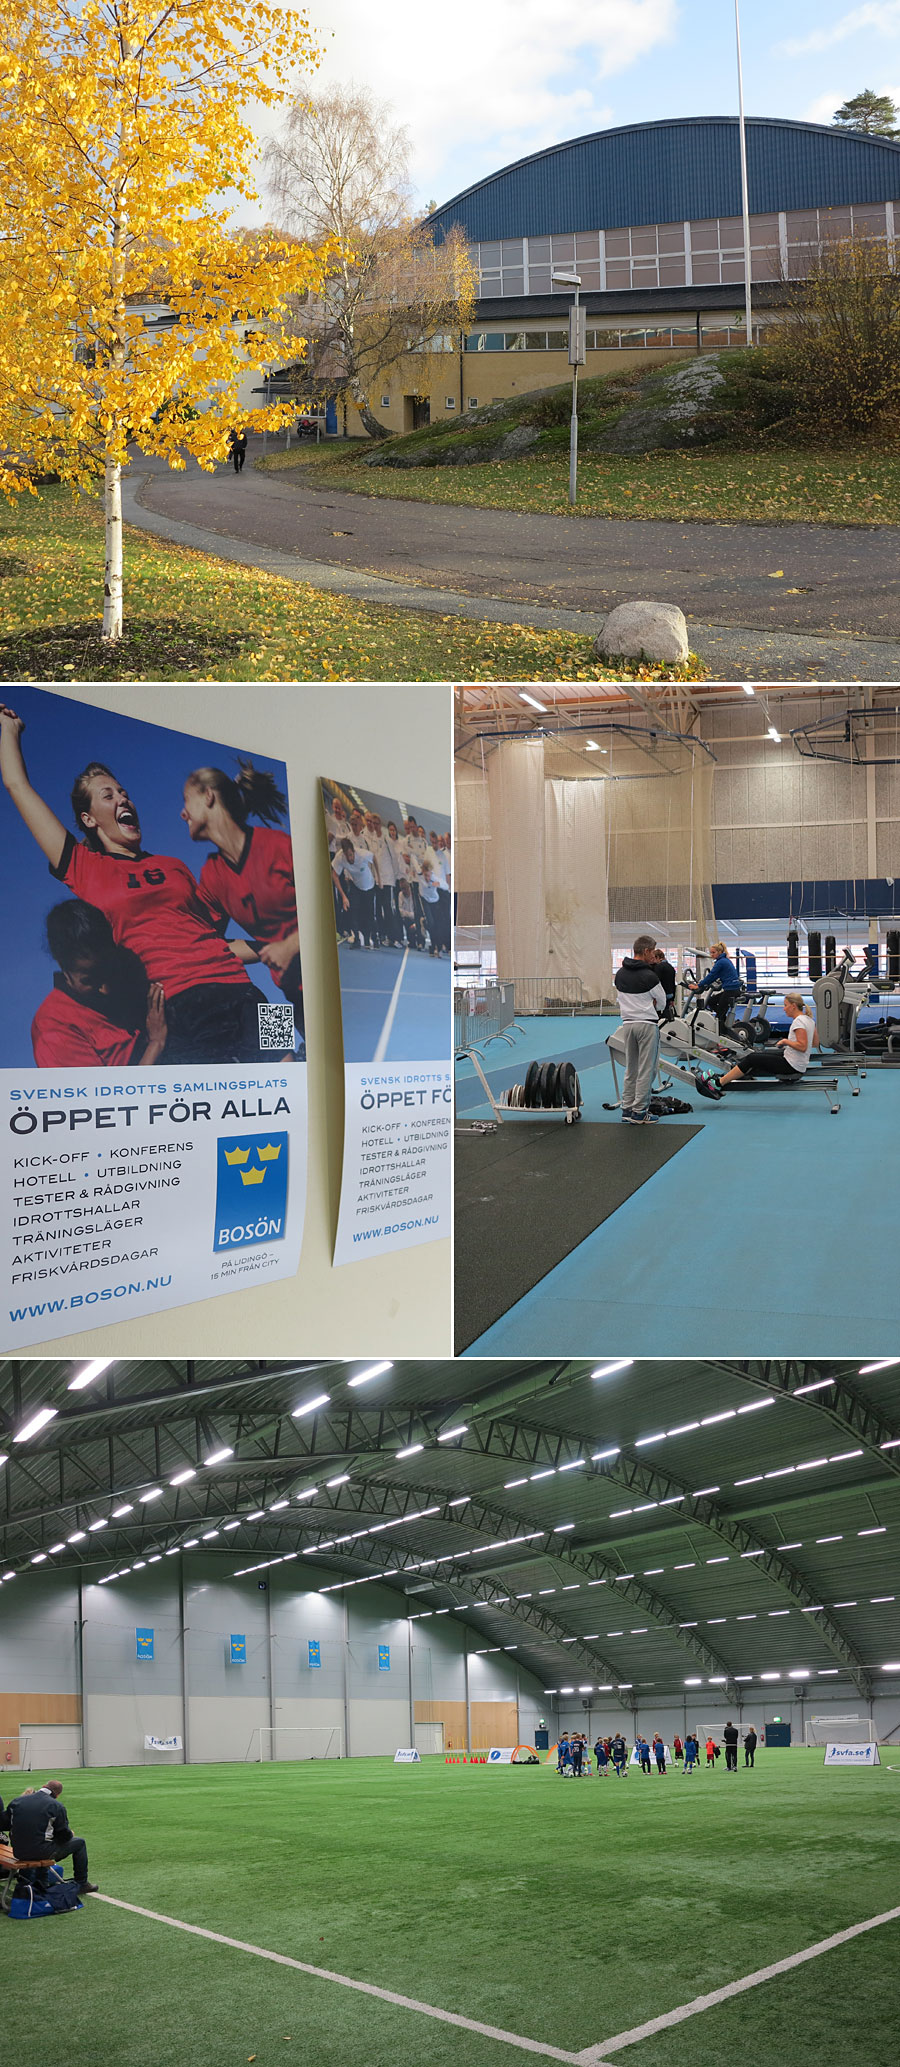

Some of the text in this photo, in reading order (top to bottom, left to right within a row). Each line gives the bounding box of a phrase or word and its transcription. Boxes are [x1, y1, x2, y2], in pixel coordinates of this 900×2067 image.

[127, 868, 166, 889] 16
[10, 1079, 287, 1101] SVENSK IDROTTS SAMLINGSPLATS
[361, 1077, 400, 1085] SVENSK
[404, 1075, 441, 1083] IDROTTS
[361, 1090, 427, 1110] ÖPPET
[10, 1097, 291, 1135] ÖPPET FÖR ALLA
[362, 1123, 401, 1133] KICK-OFF
[362, 1130, 448, 1147] HOTELL UTBILDNING
[14, 1142, 193, 1168] KICK-OFF KONFERENS
[361, 1150, 392, 1161] TESTER
[402, 1142, 447, 1155] RÅDGIVNING
[14, 1160, 181, 1188] HOTELL UTBILDNING
[360, 1159, 426, 1175] IDROTTSHALLAR
[359, 1171, 426, 1188] TRÄNINGSLÄGER
[14, 1177, 180, 1207] TESTER & RÅDGIVNING
[357, 1186, 409, 1202] AKTIVITETER
[14, 1200, 140, 1227] IDROTTSHALLAR
[356, 1194, 433, 1215] FRISKVÅRDSDAGAR
[13, 1217, 143, 1246] TRÄNINGSLÄGER
[219, 1216, 281, 1245] BOSÖN
[353, 1215, 439, 1243] WWW.BOSON.NU
[12, 1239, 111, 1265] AKTIVITETER
[222, 1261, 232, 1269] PÅ
[235, 1253, 267, 1266] LIDINGÖ
[12, 1248, 159, 1284] FRISKVÅRDSDAGAR
[221, 1269, 236, 1277] MIN
[239, 1264, 260, 1273] FRÅN
[262, 1259, 279, 1267] CITY
[9, 1275, 172, 1322] WWW.BOSON.NU
